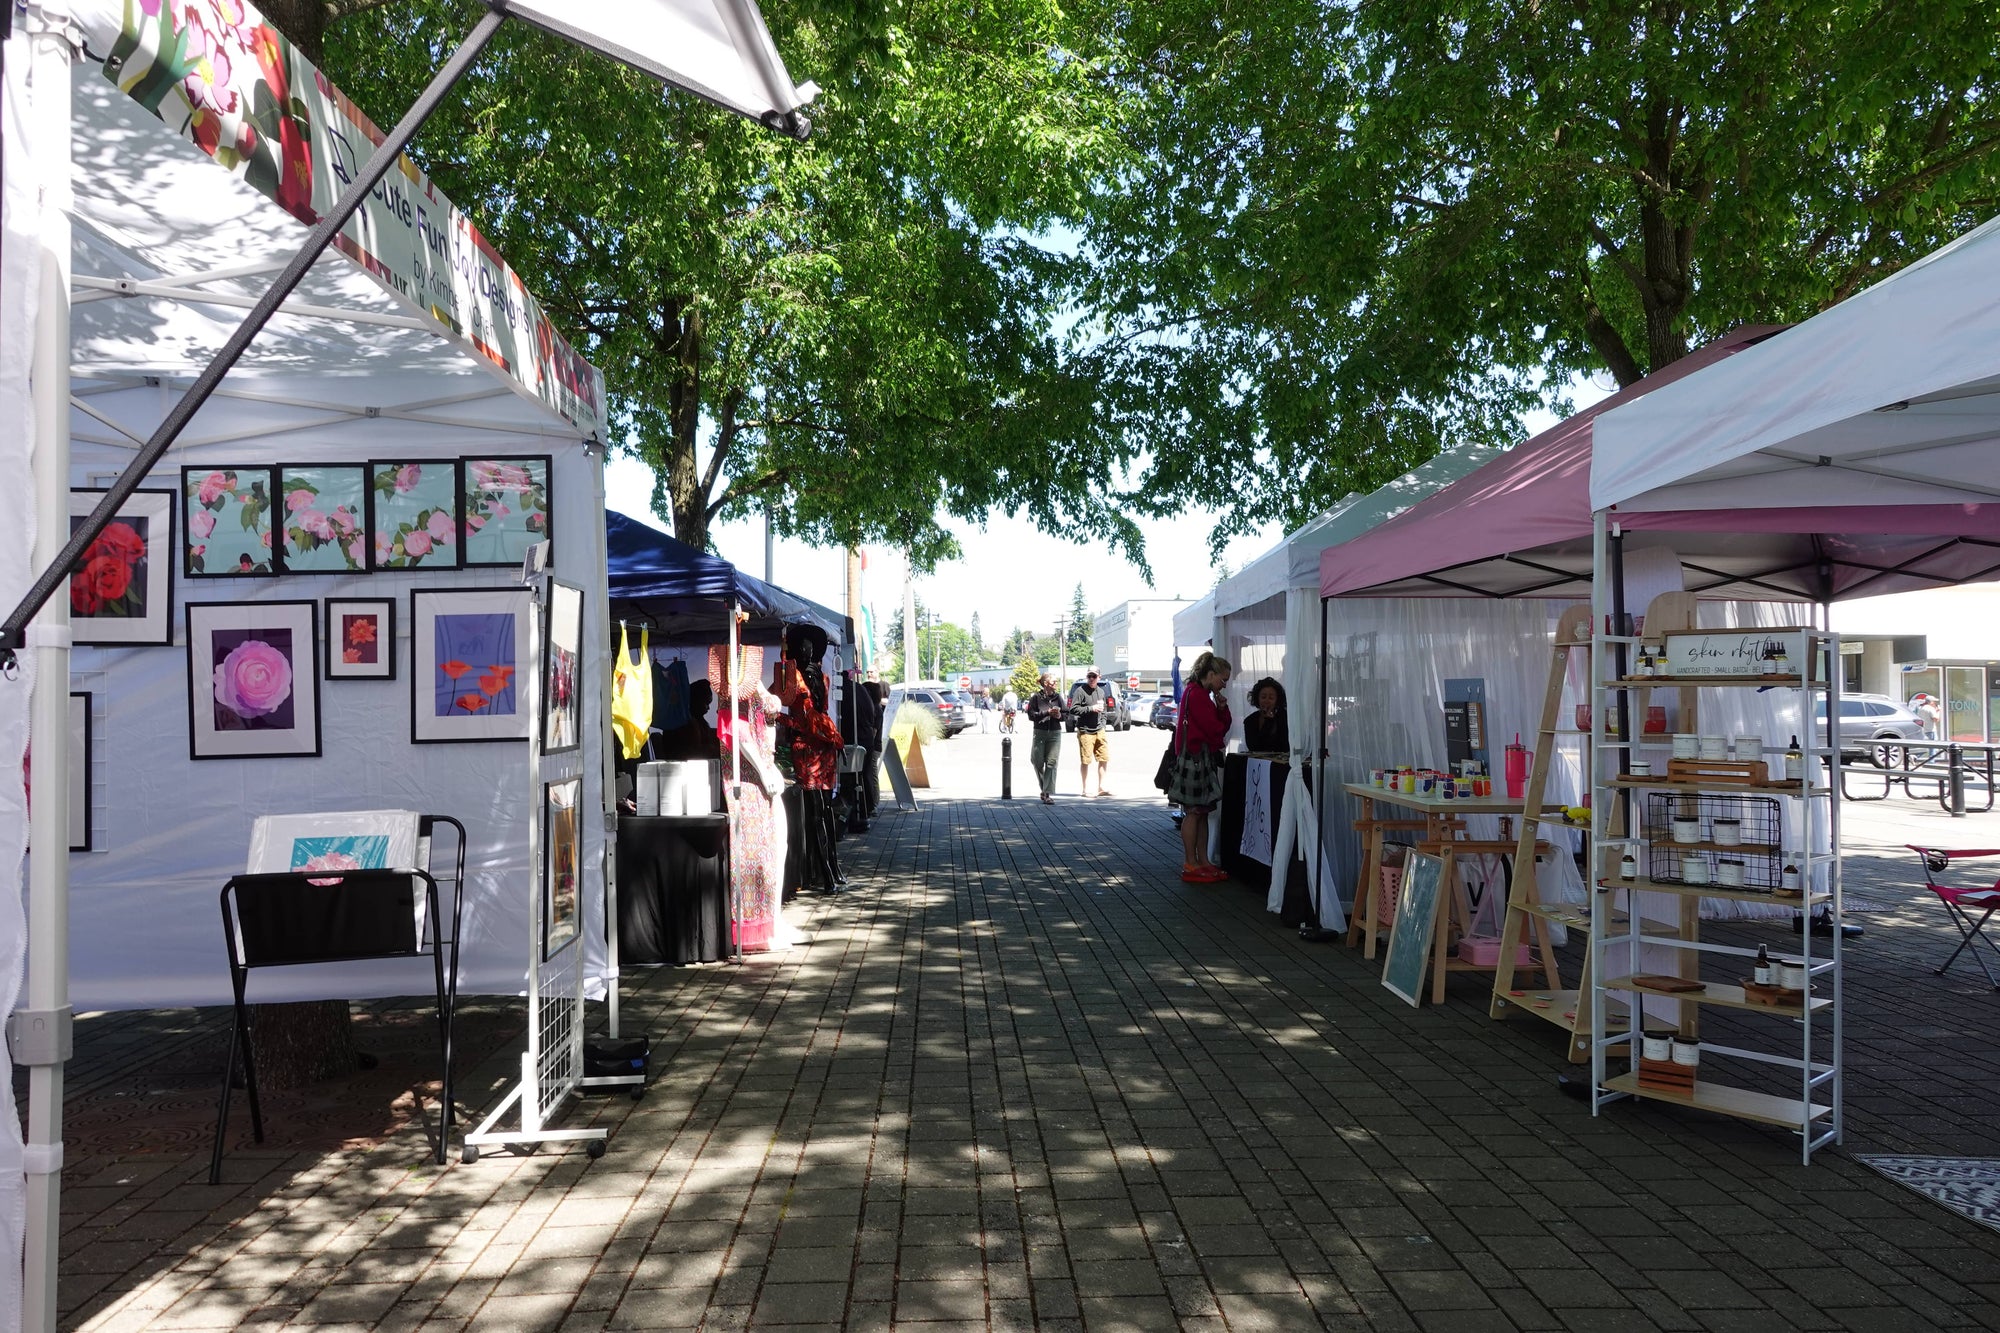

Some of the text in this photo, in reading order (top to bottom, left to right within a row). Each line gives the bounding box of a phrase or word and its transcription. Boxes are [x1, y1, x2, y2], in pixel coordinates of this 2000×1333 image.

[413, 252, 428, 289] by
[416, 204, 449, 262] Fun
[481, 265, 530, 334] Designs
[1688, 636, 1725, 662] skin
[1714, 666, 1731, 674] SMALL
[1732, 665, 1749, 673] BATCH
